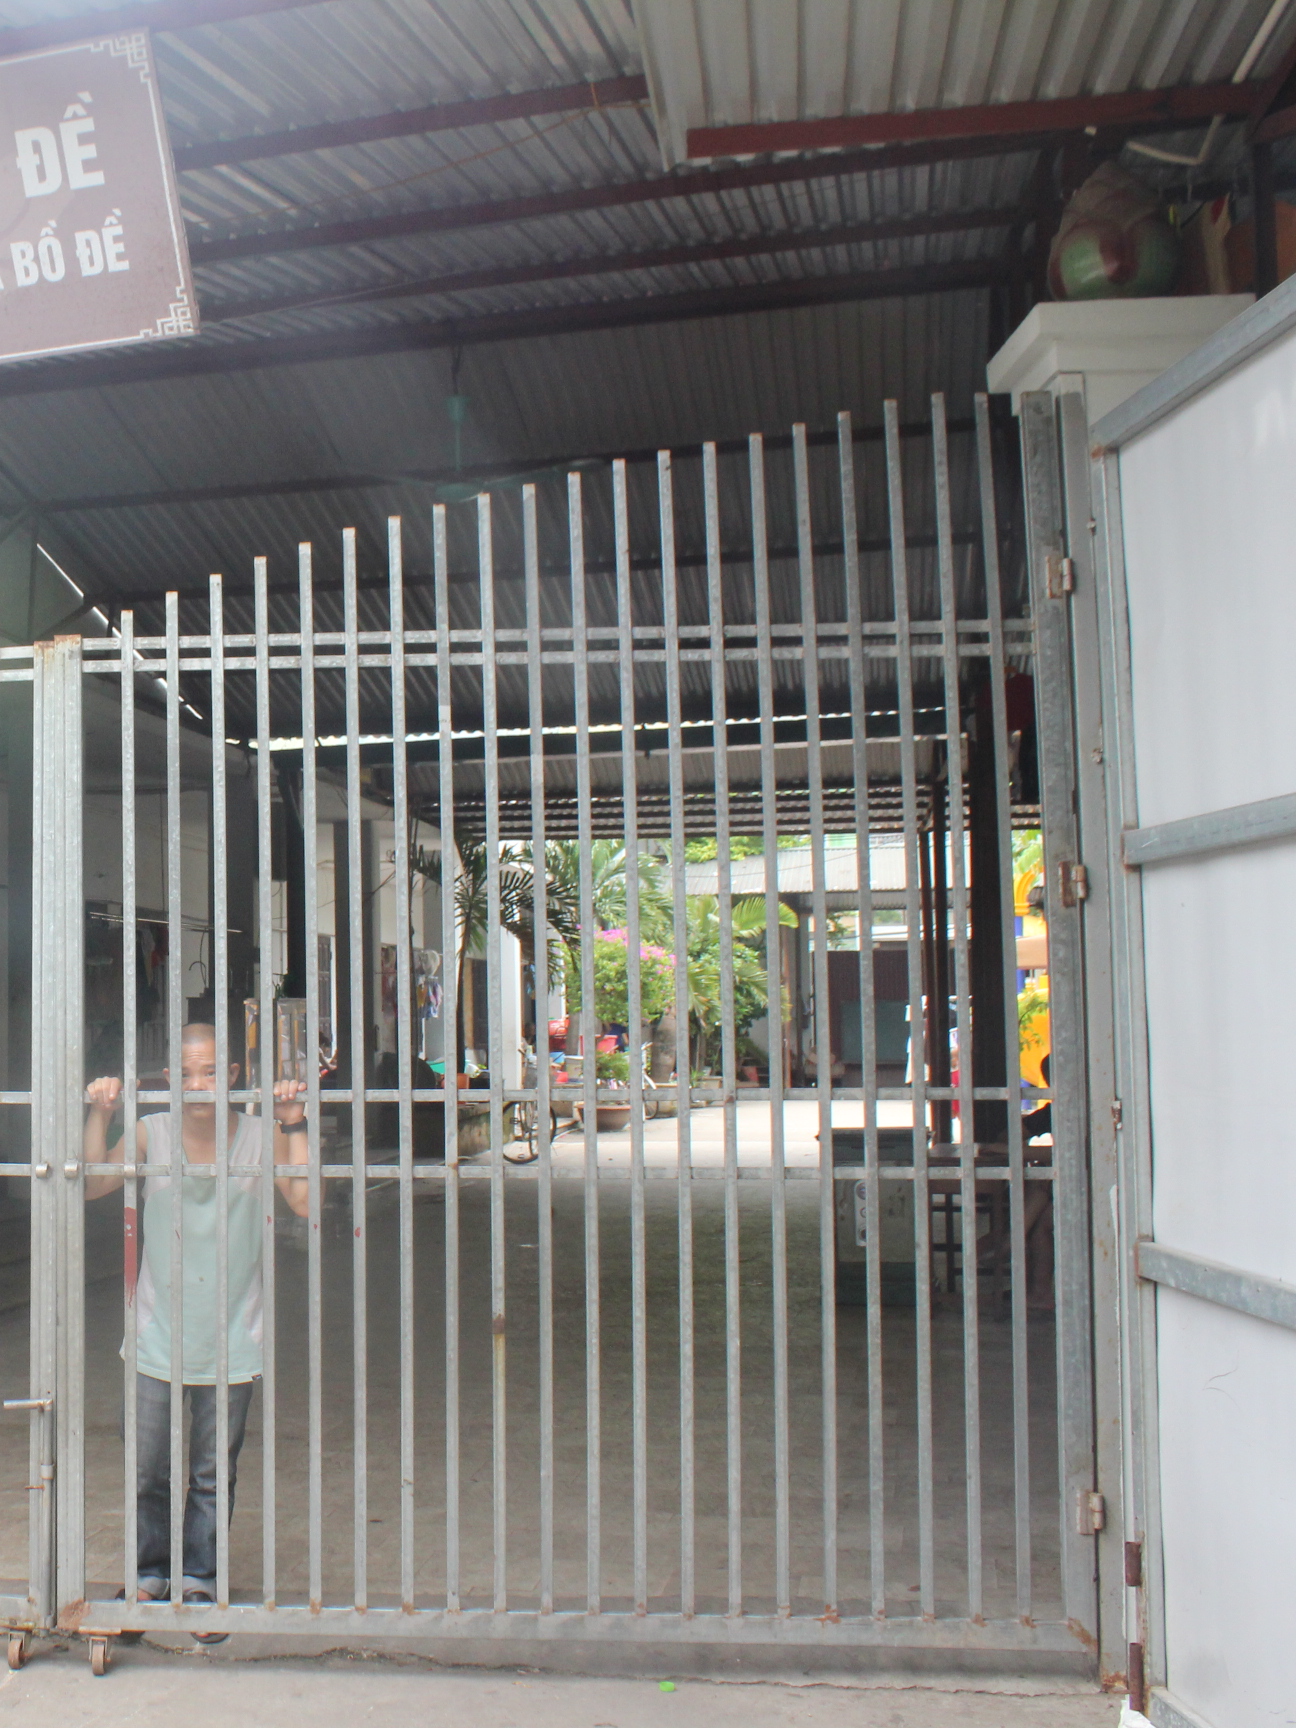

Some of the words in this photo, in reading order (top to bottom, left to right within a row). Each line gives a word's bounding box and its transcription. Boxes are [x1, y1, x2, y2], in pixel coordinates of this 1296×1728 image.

[14, 91, 105, 198] ĐỀ
[10, 220, 65, 287] BỒ
[74, 208, 129, 277] ĐỀ
